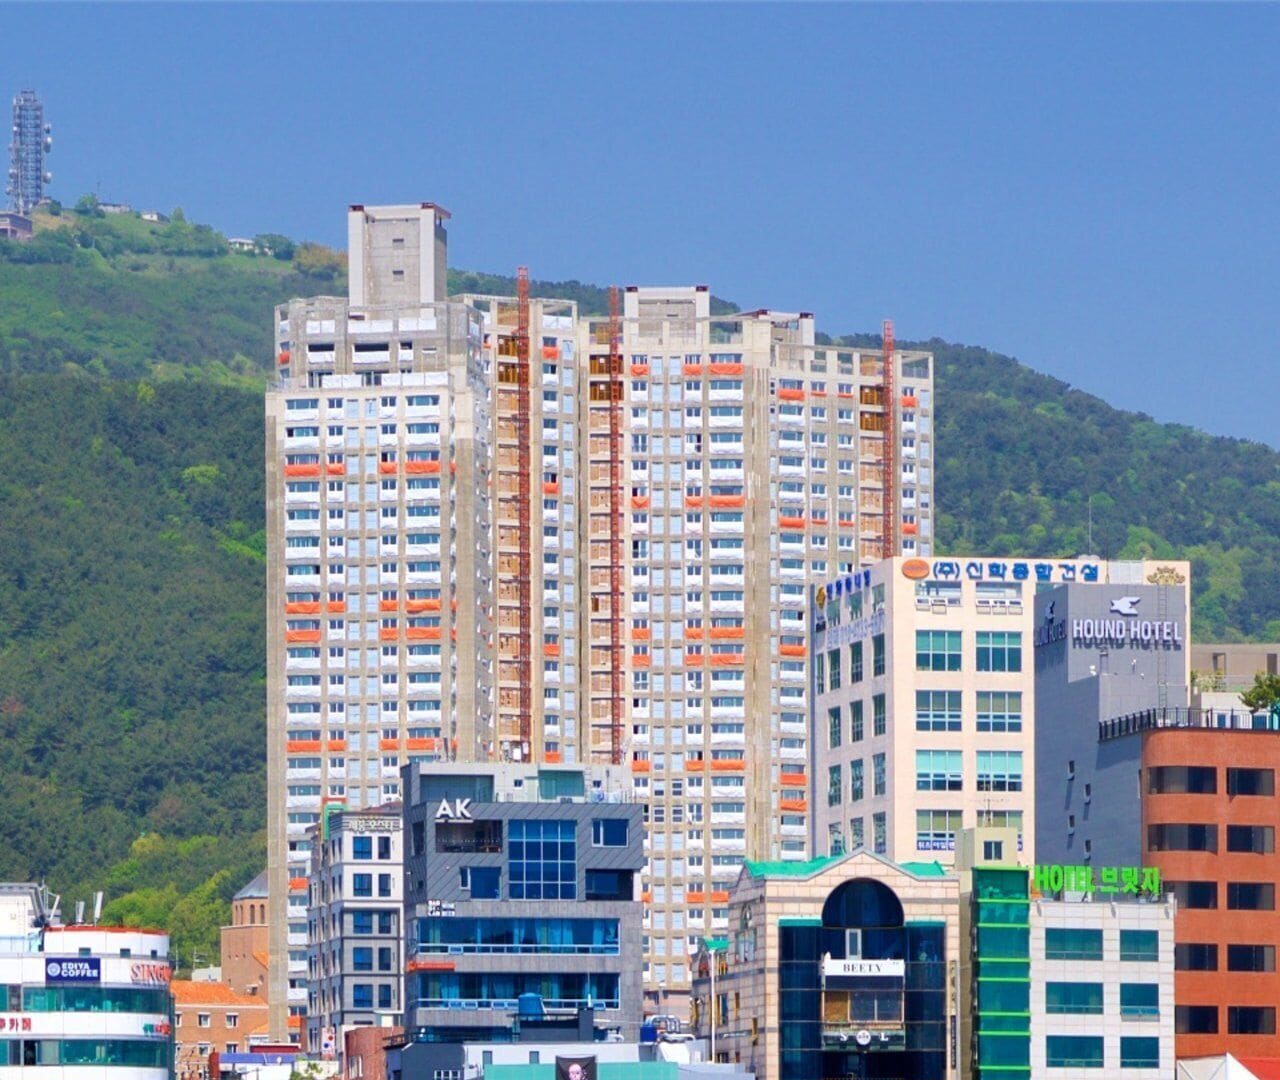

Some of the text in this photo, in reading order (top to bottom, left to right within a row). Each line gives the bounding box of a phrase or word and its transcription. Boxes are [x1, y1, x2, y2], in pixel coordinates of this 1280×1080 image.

[1073, 619, 1182, 640] HOUND HOTEL
[435, 798, 472, 818] AK
[1034, 865, 1160, 895] HOTEL 브릿지
[61, 969, 98, 977] COFFEE
